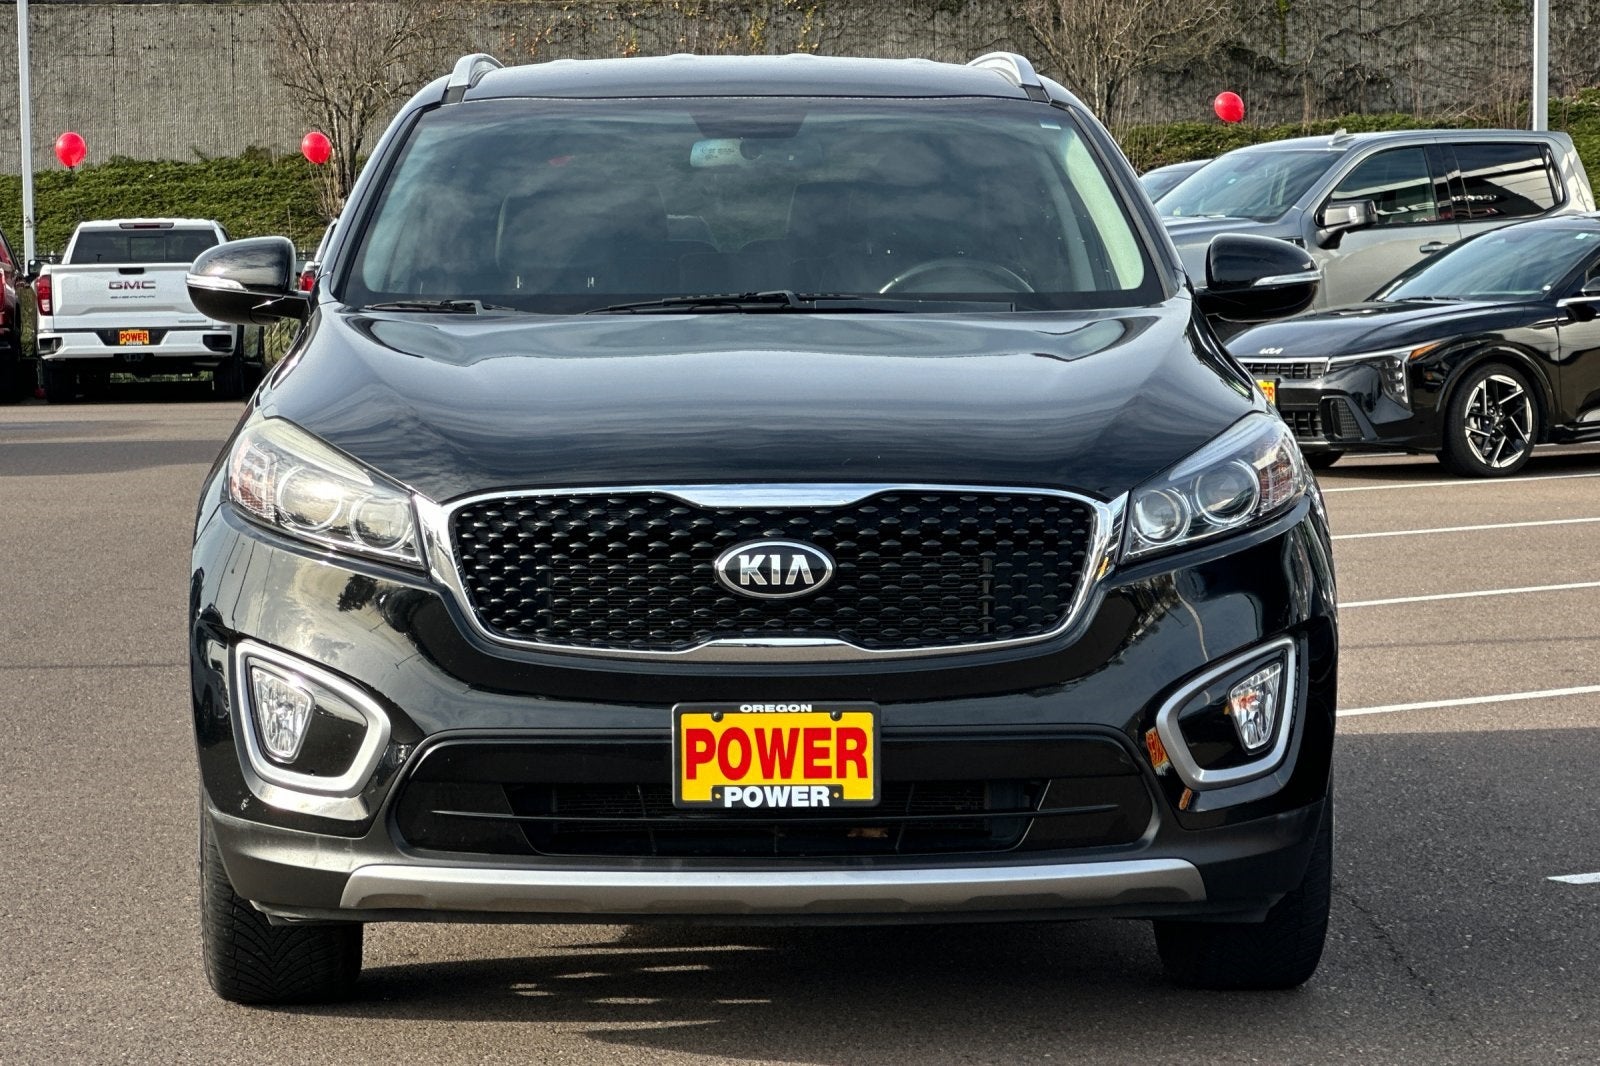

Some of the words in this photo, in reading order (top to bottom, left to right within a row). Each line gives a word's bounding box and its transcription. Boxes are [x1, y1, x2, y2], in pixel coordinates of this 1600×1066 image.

[109, 281, 156, 290] GMC
[120, 332, 148, 342] POWER
[739, 554, 815, 585] KIA
[740, 704, 812, 713] OREGON
[686, 727, 868, 780] POWER
[724, 786, 830, 808] POWER
